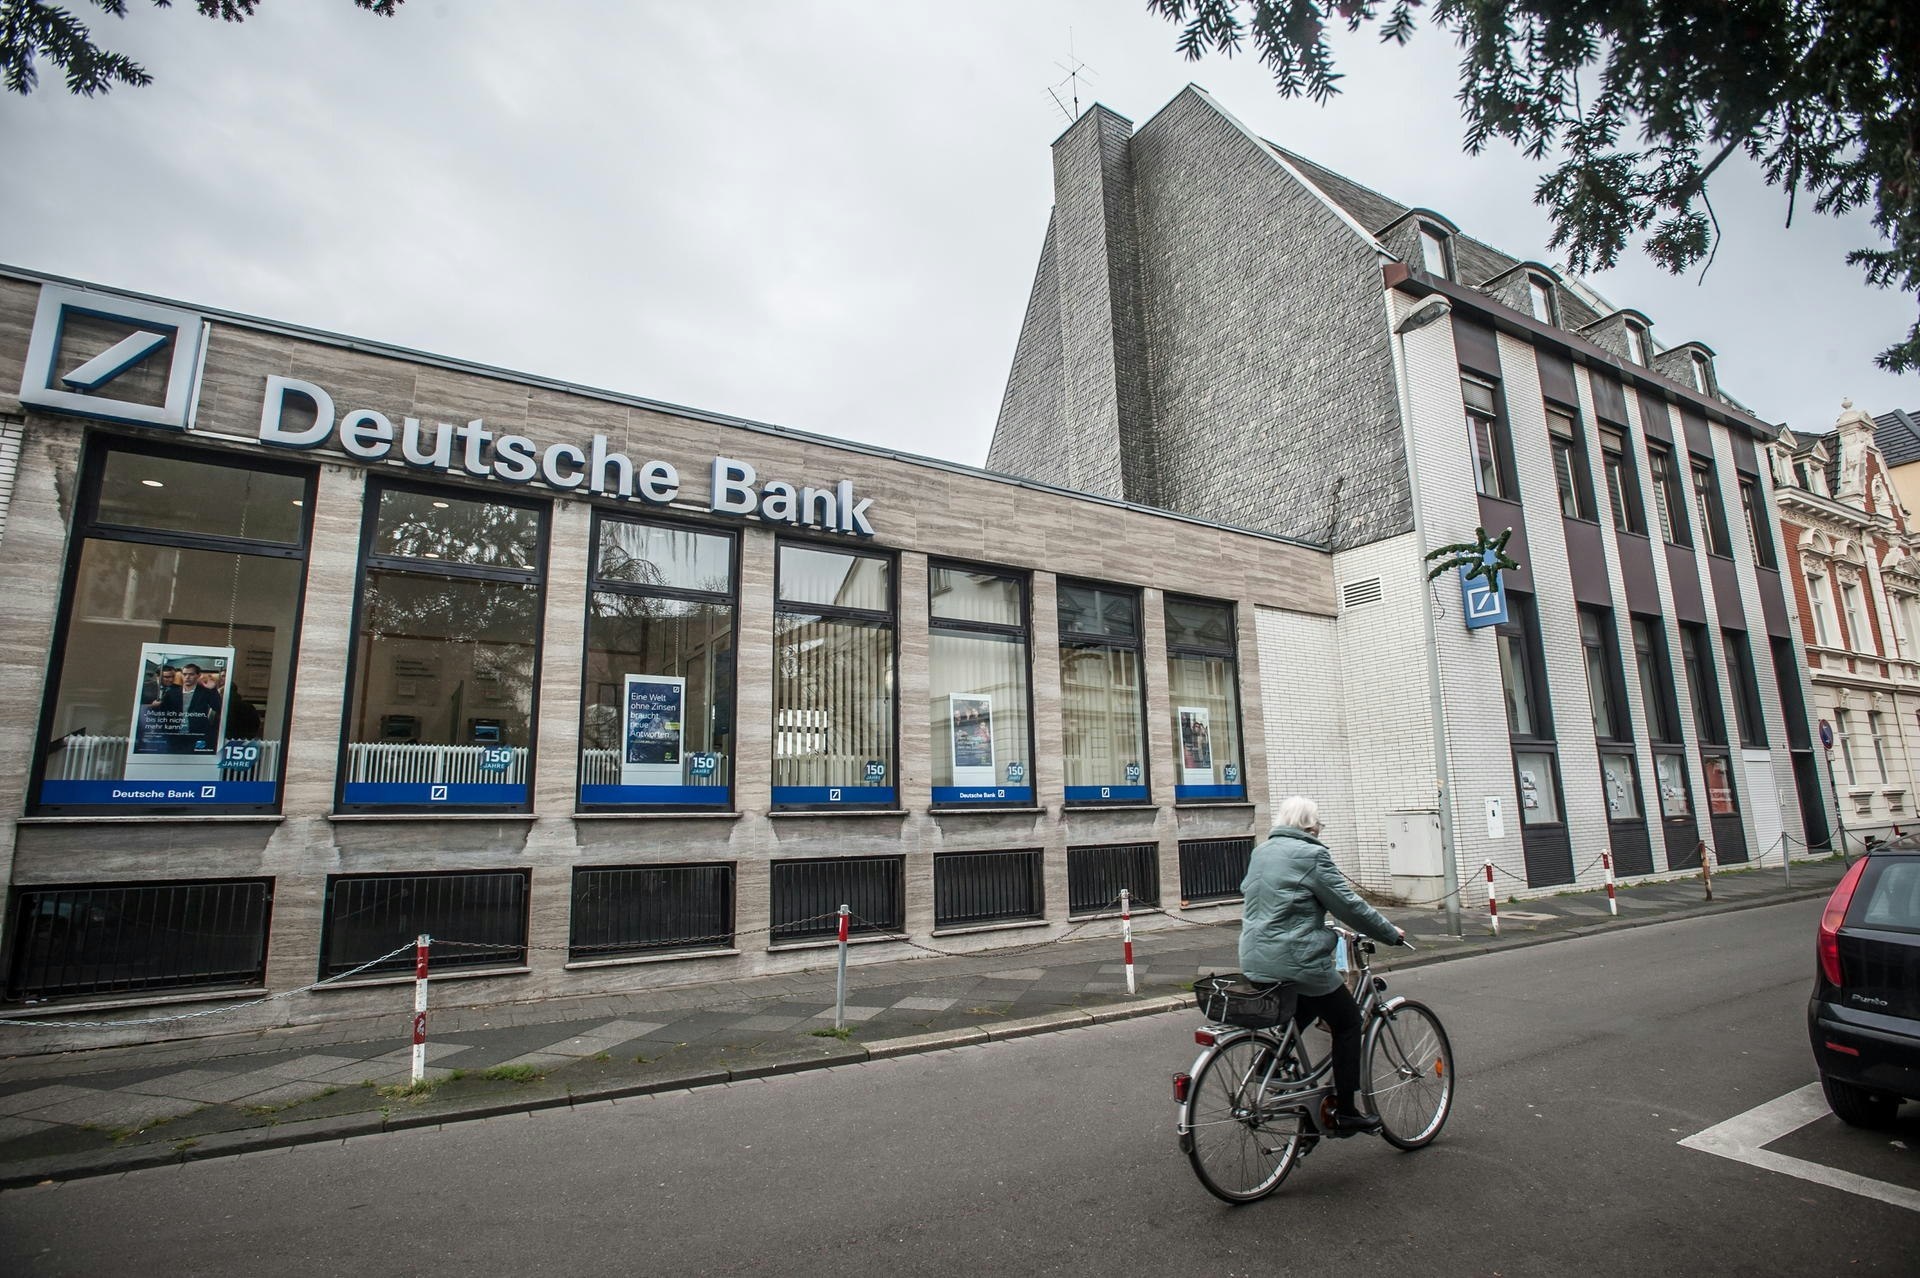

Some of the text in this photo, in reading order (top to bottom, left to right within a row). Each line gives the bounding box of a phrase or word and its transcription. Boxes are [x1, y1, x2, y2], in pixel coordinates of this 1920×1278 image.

[258, 374, 874, 537] Deutsche Bank
[631, 692, 667, 702] Eine Welt
[630, 702, 676, 712] ohne Zinsen
[630, 711, 660, 720] braucht
[630, 721, 649, 729] neue
[629, 730, 670, 739] Antworten
[224, 746, 257, 761] 150
[484, 750, 511, 763] 150
[692, 757, 715, 769] 150
[866, 765, 884, 775] 150
[1008, 766, 1024, 776] 150
[1126, 766, 1140, 776] 150
[1225, 767, 1237, 775] 150
[112, 789, 195, 798] Deutsche Bank
[1851, 993, 1888, 1006] Punto
